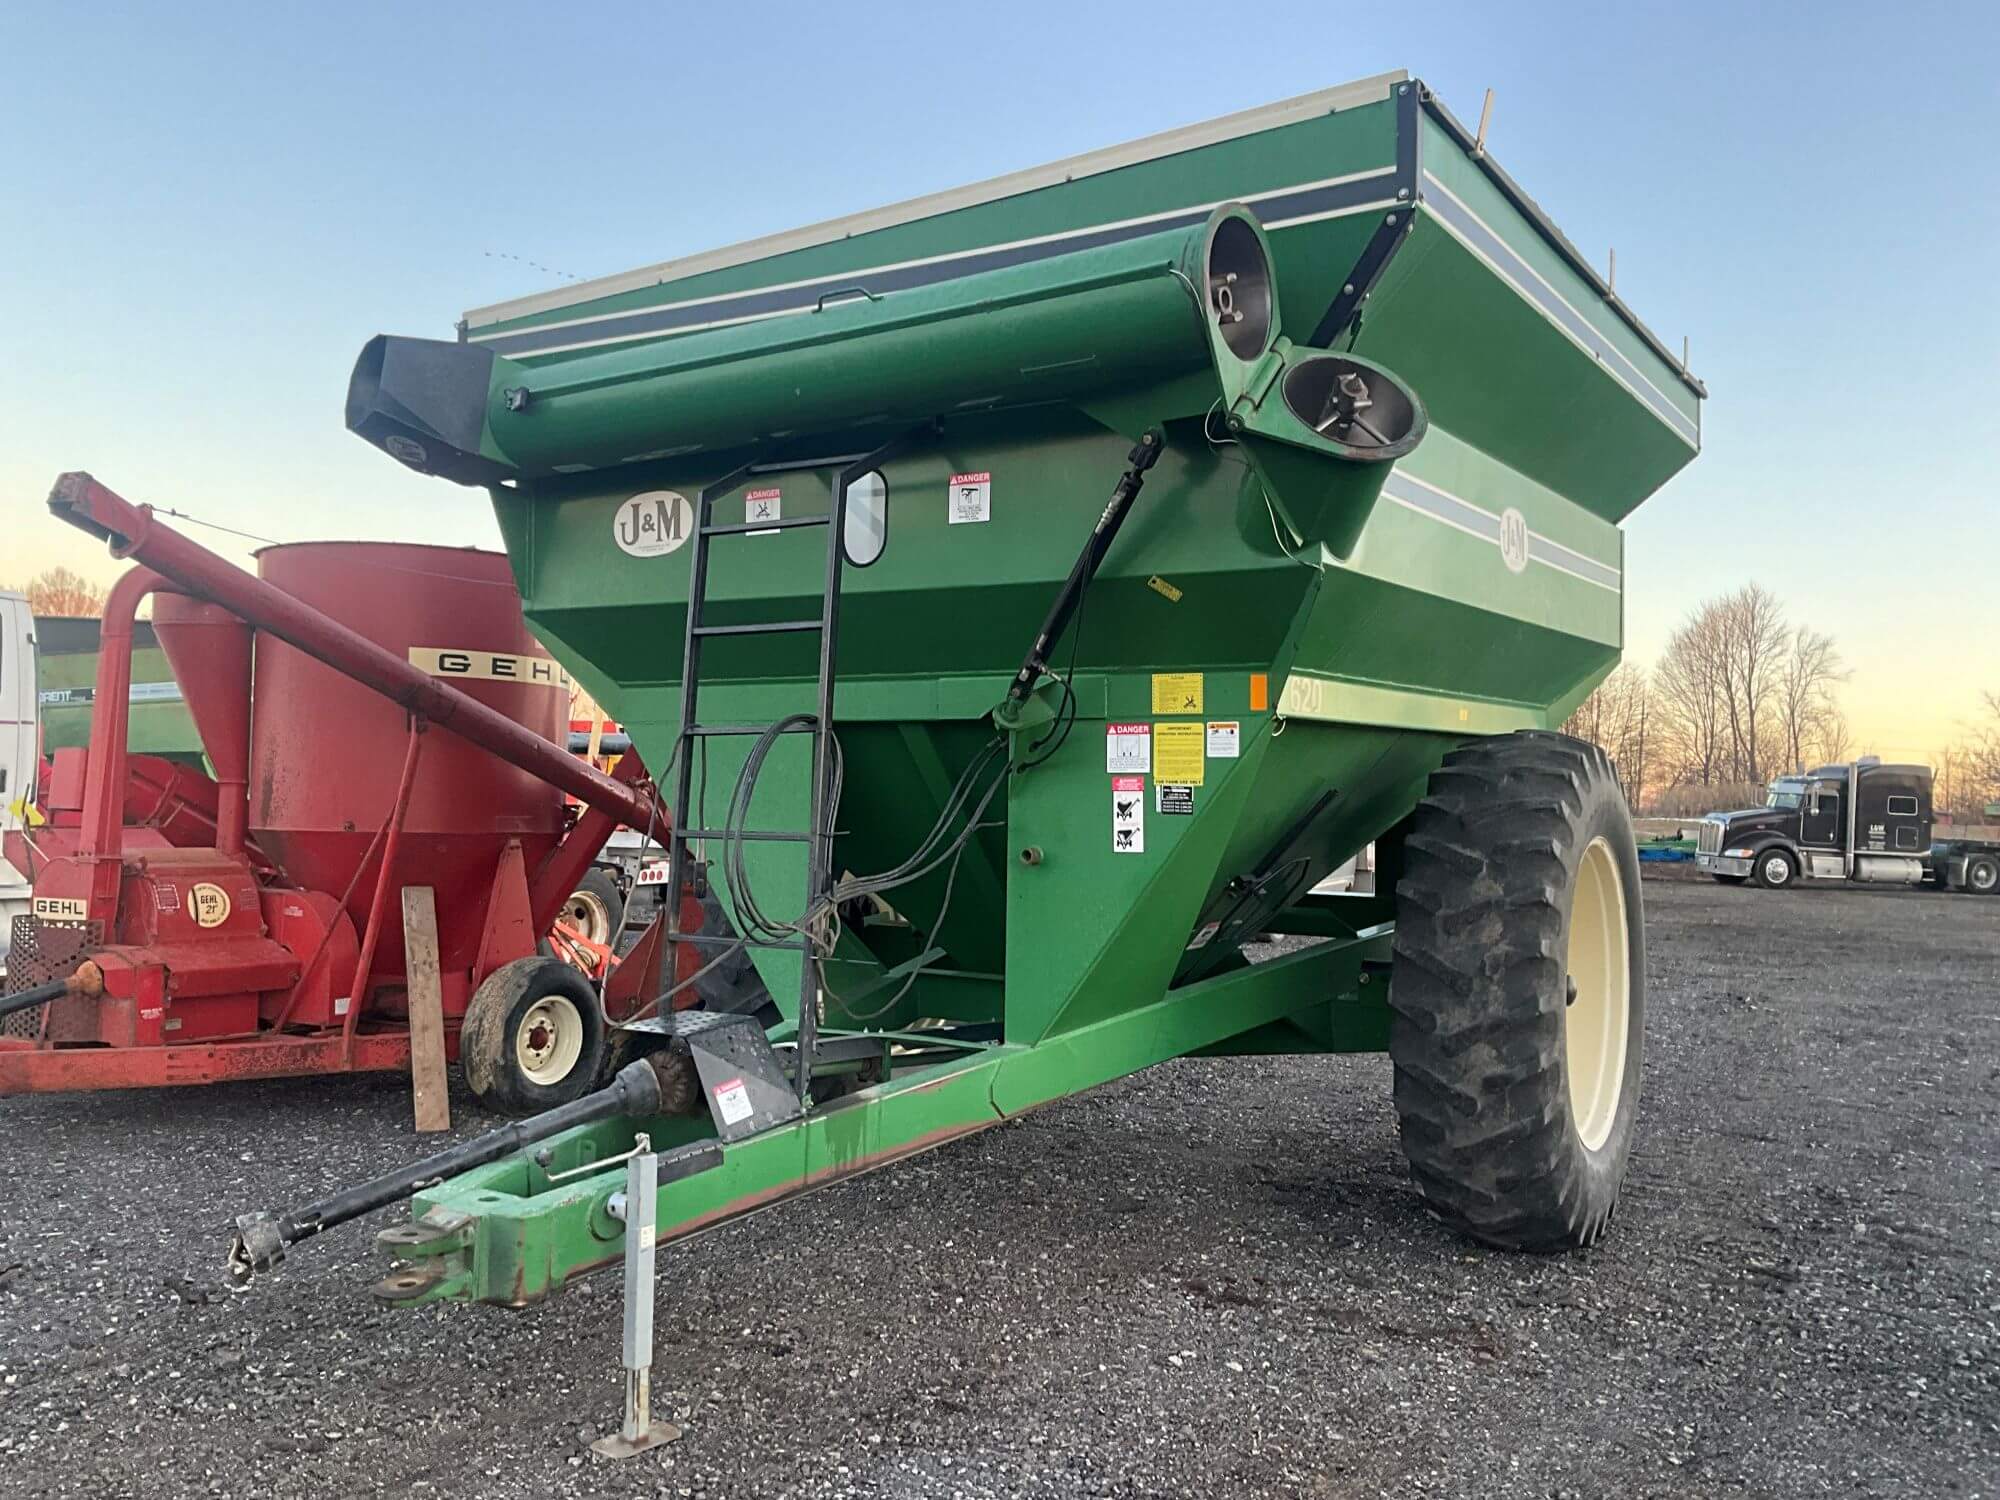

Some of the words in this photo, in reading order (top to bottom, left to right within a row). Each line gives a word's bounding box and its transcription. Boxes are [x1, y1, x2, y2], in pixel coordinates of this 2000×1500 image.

[957, 472, 990, 483] DANGER
[752, 488, 780, 499] DANGER
[620, 497, 683, 546] J&M
[438, 653, 569, 684] GEHL
[1117, 725, 1149, 734] DANGER
[200, 895, 218, 904] GEHL
[36, 900, 84, 915] GEHL
